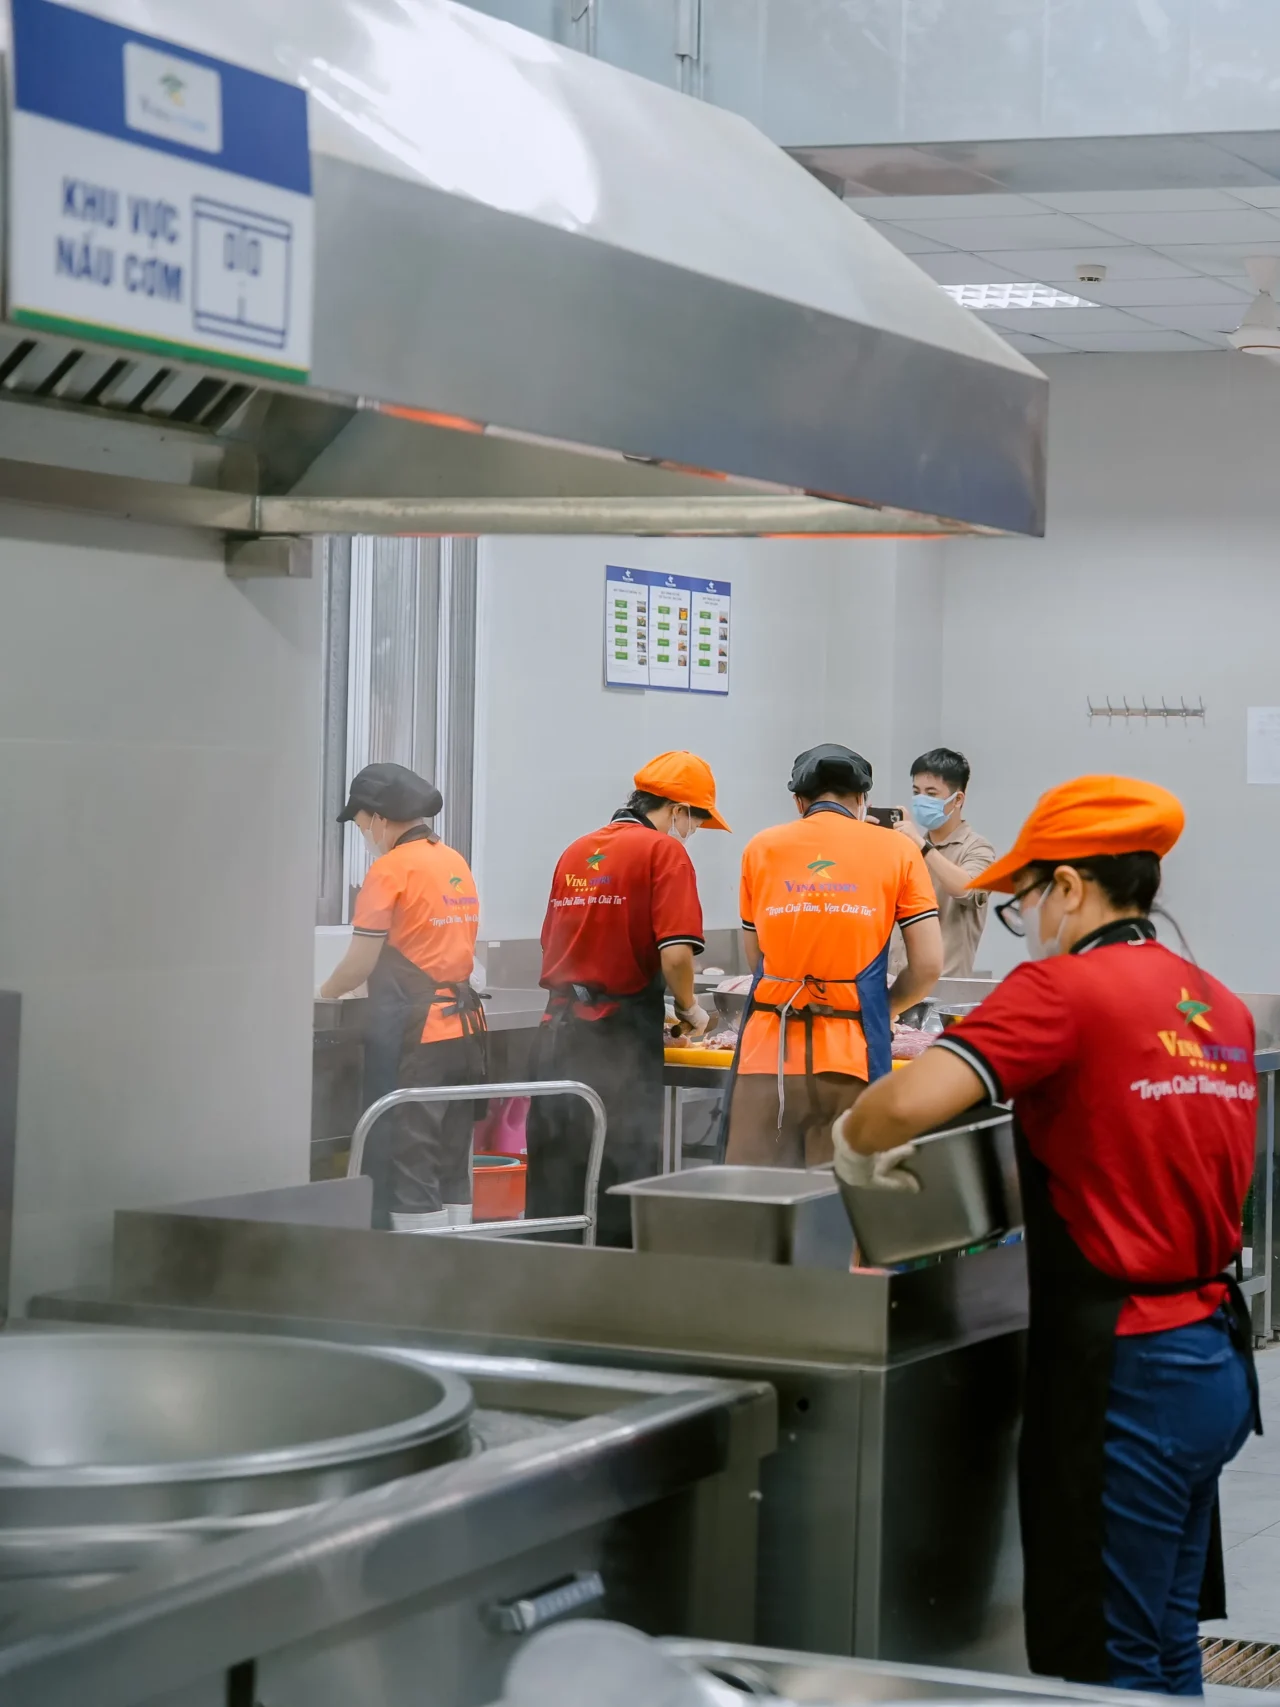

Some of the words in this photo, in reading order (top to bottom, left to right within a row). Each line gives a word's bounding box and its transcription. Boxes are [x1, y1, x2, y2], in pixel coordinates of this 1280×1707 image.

[62, 176, 119, 228] KHU
[565, 874, 587, 887] VINA
[784, 880, 816, 893] VINA
[824, 903, 839, 914] Vẹn
